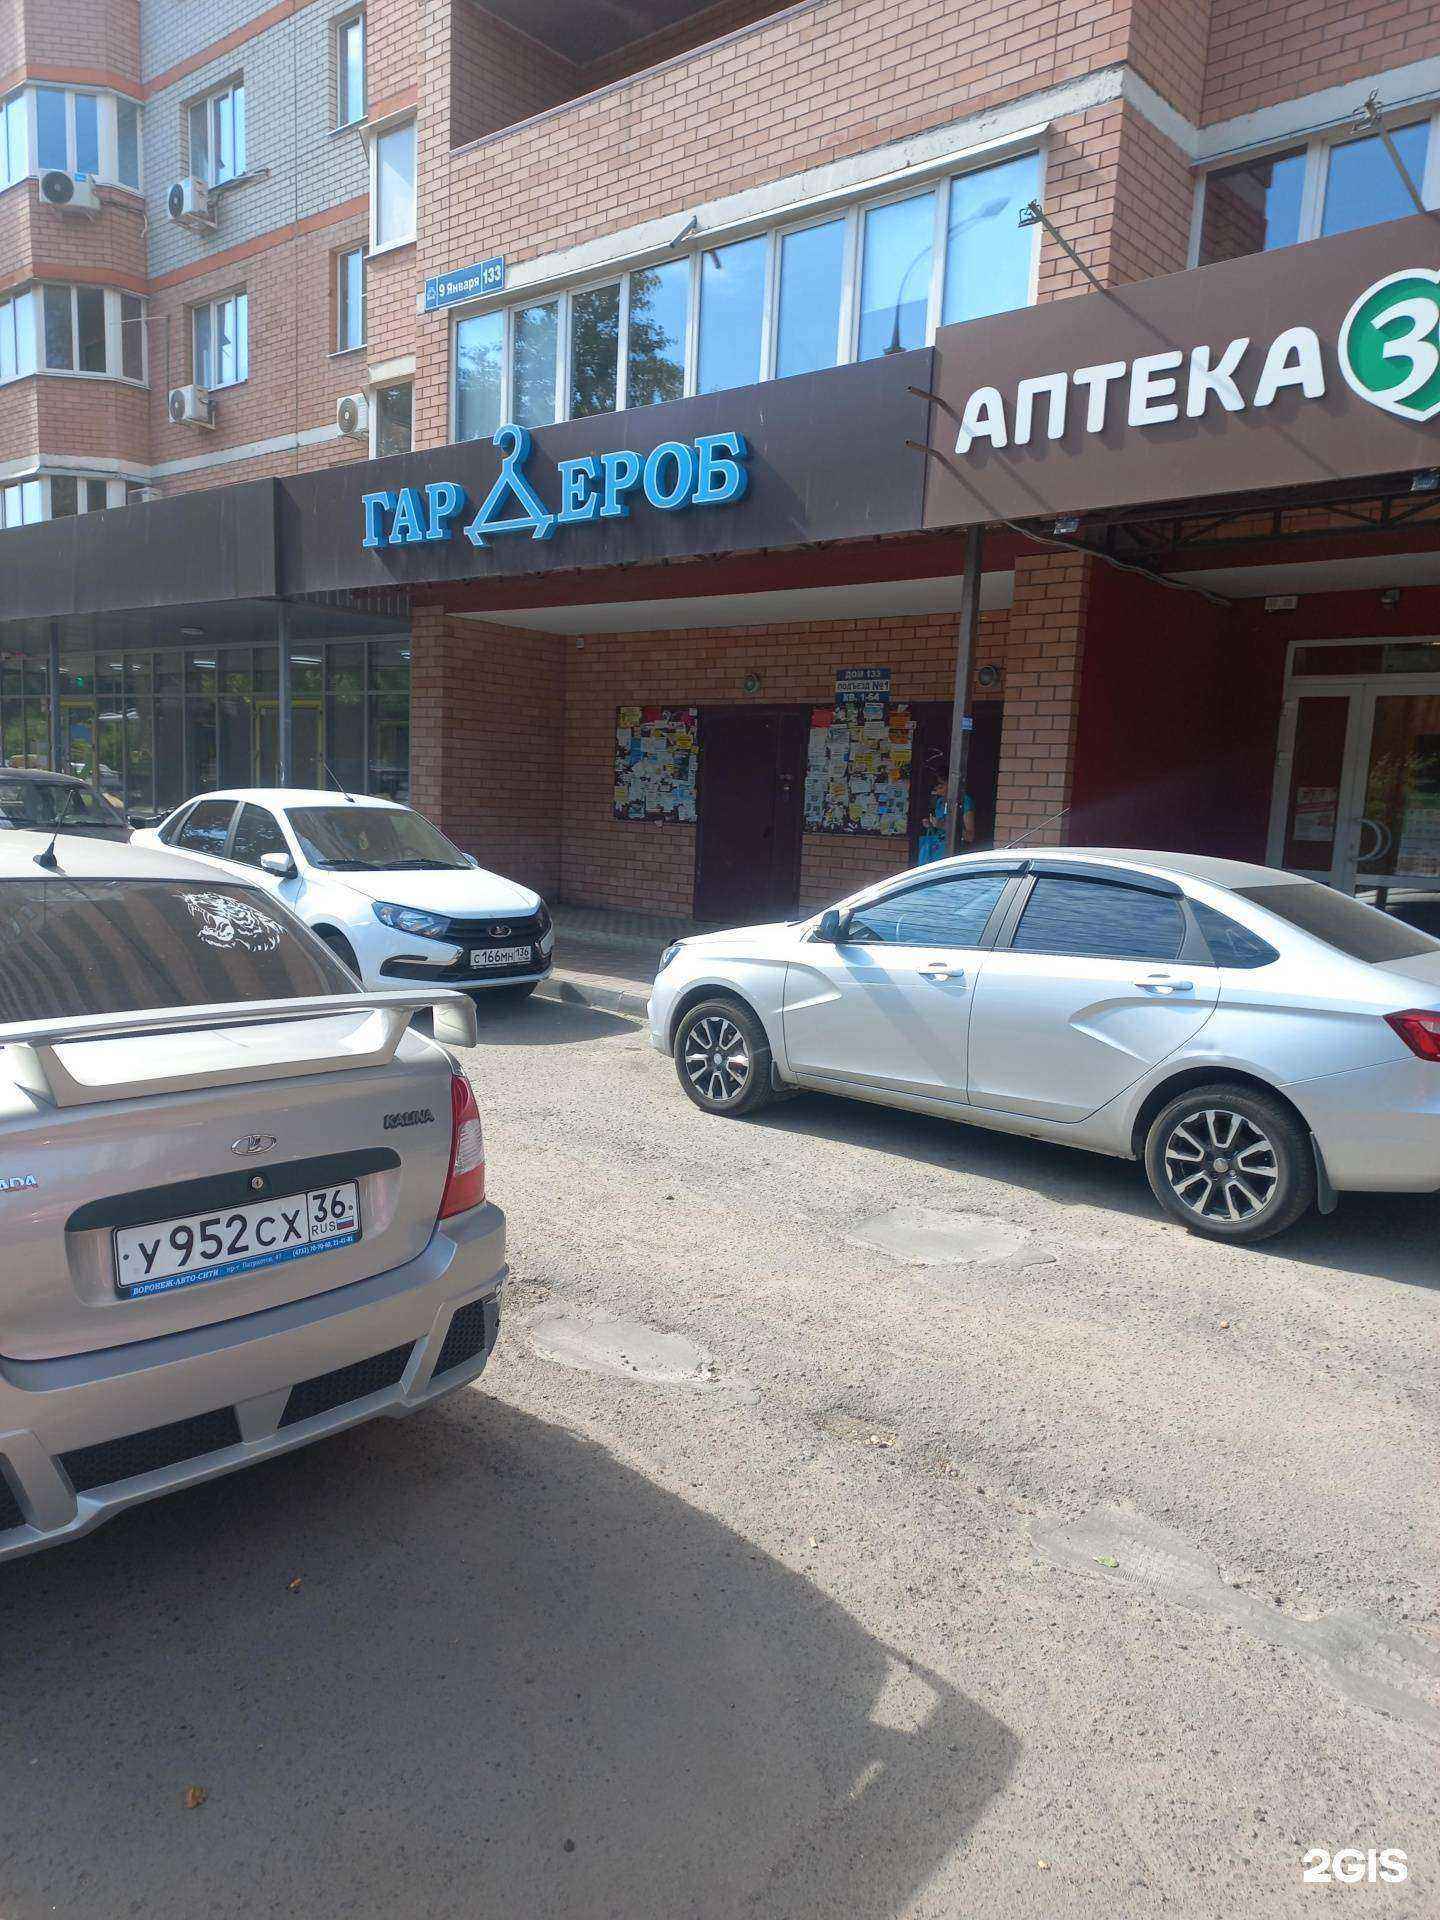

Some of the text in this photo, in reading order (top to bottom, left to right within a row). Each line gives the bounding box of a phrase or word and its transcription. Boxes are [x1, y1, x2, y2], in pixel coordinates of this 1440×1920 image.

[438, 264, 501, 298] 9 Января 133
[954, 326, 1327, 455] АПТЕКА
[361, 423, 749, 549] ГАРДЕРОБ
[515, 946, 529, 958] 136
[383, 1108, 436, 1130] KALINA
[137, 1189, 346, 1275] У952СХ 36
[311, 1220, 336, 1236] RUS
